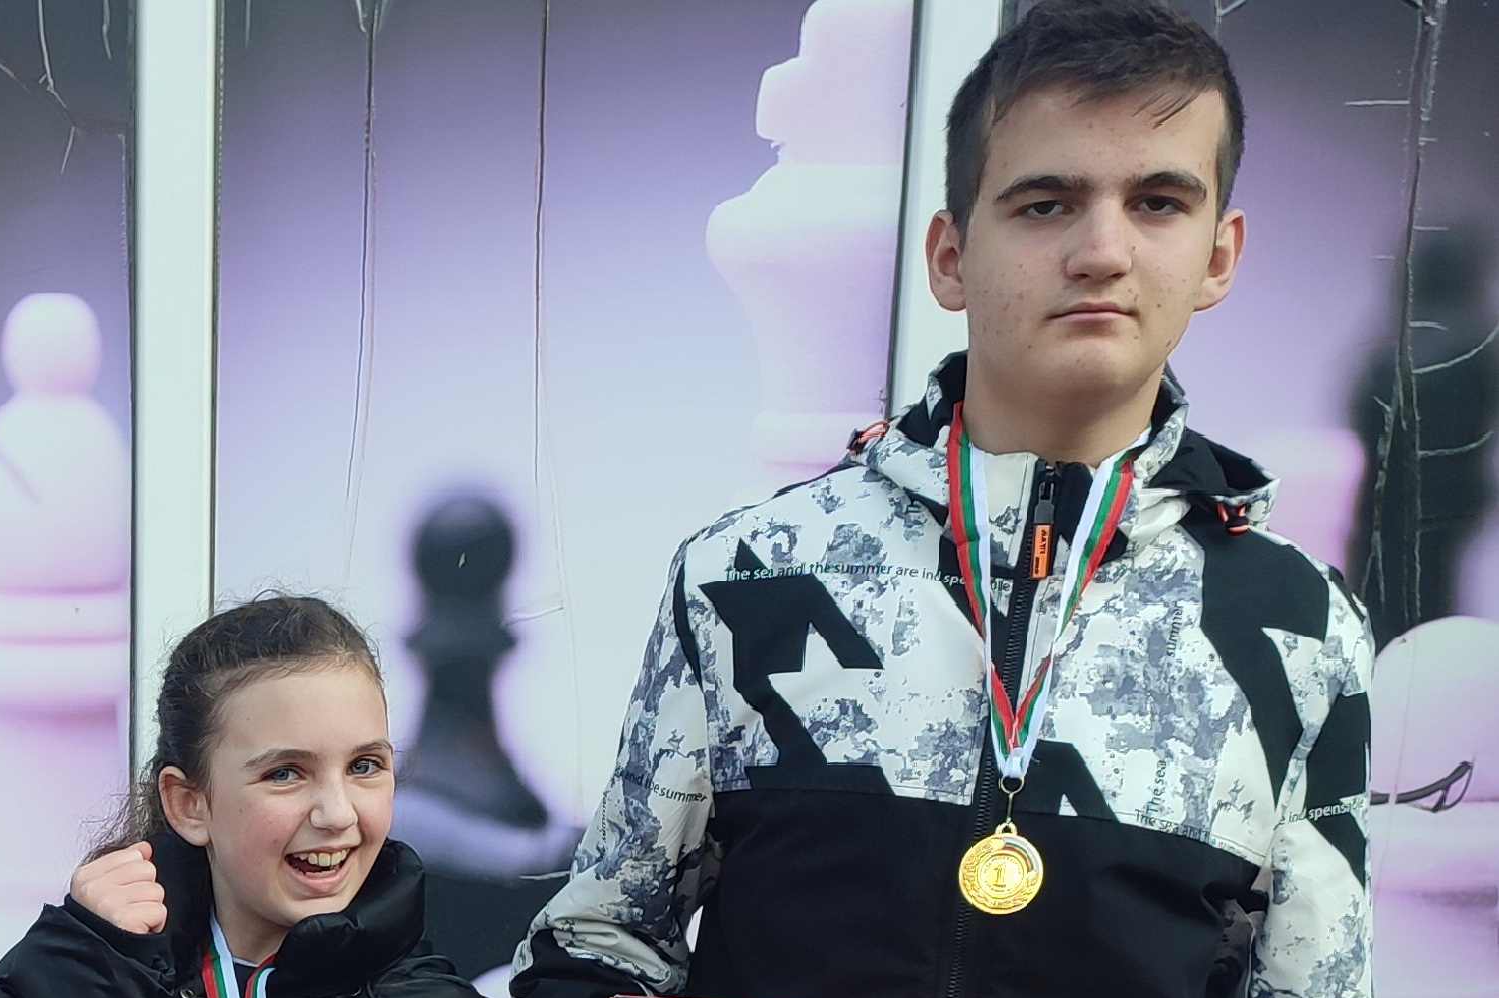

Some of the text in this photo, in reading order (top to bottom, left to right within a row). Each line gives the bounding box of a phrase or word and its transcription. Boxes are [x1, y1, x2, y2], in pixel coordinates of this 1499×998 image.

[725, 566, 750, 581] The
[778, 563, 806, 577] and
[809, 562, 832, 576] the
[833, 562, 893, 576] summer
[896, 565, 919, 578] are
[659, 787, 707, 803] summer
